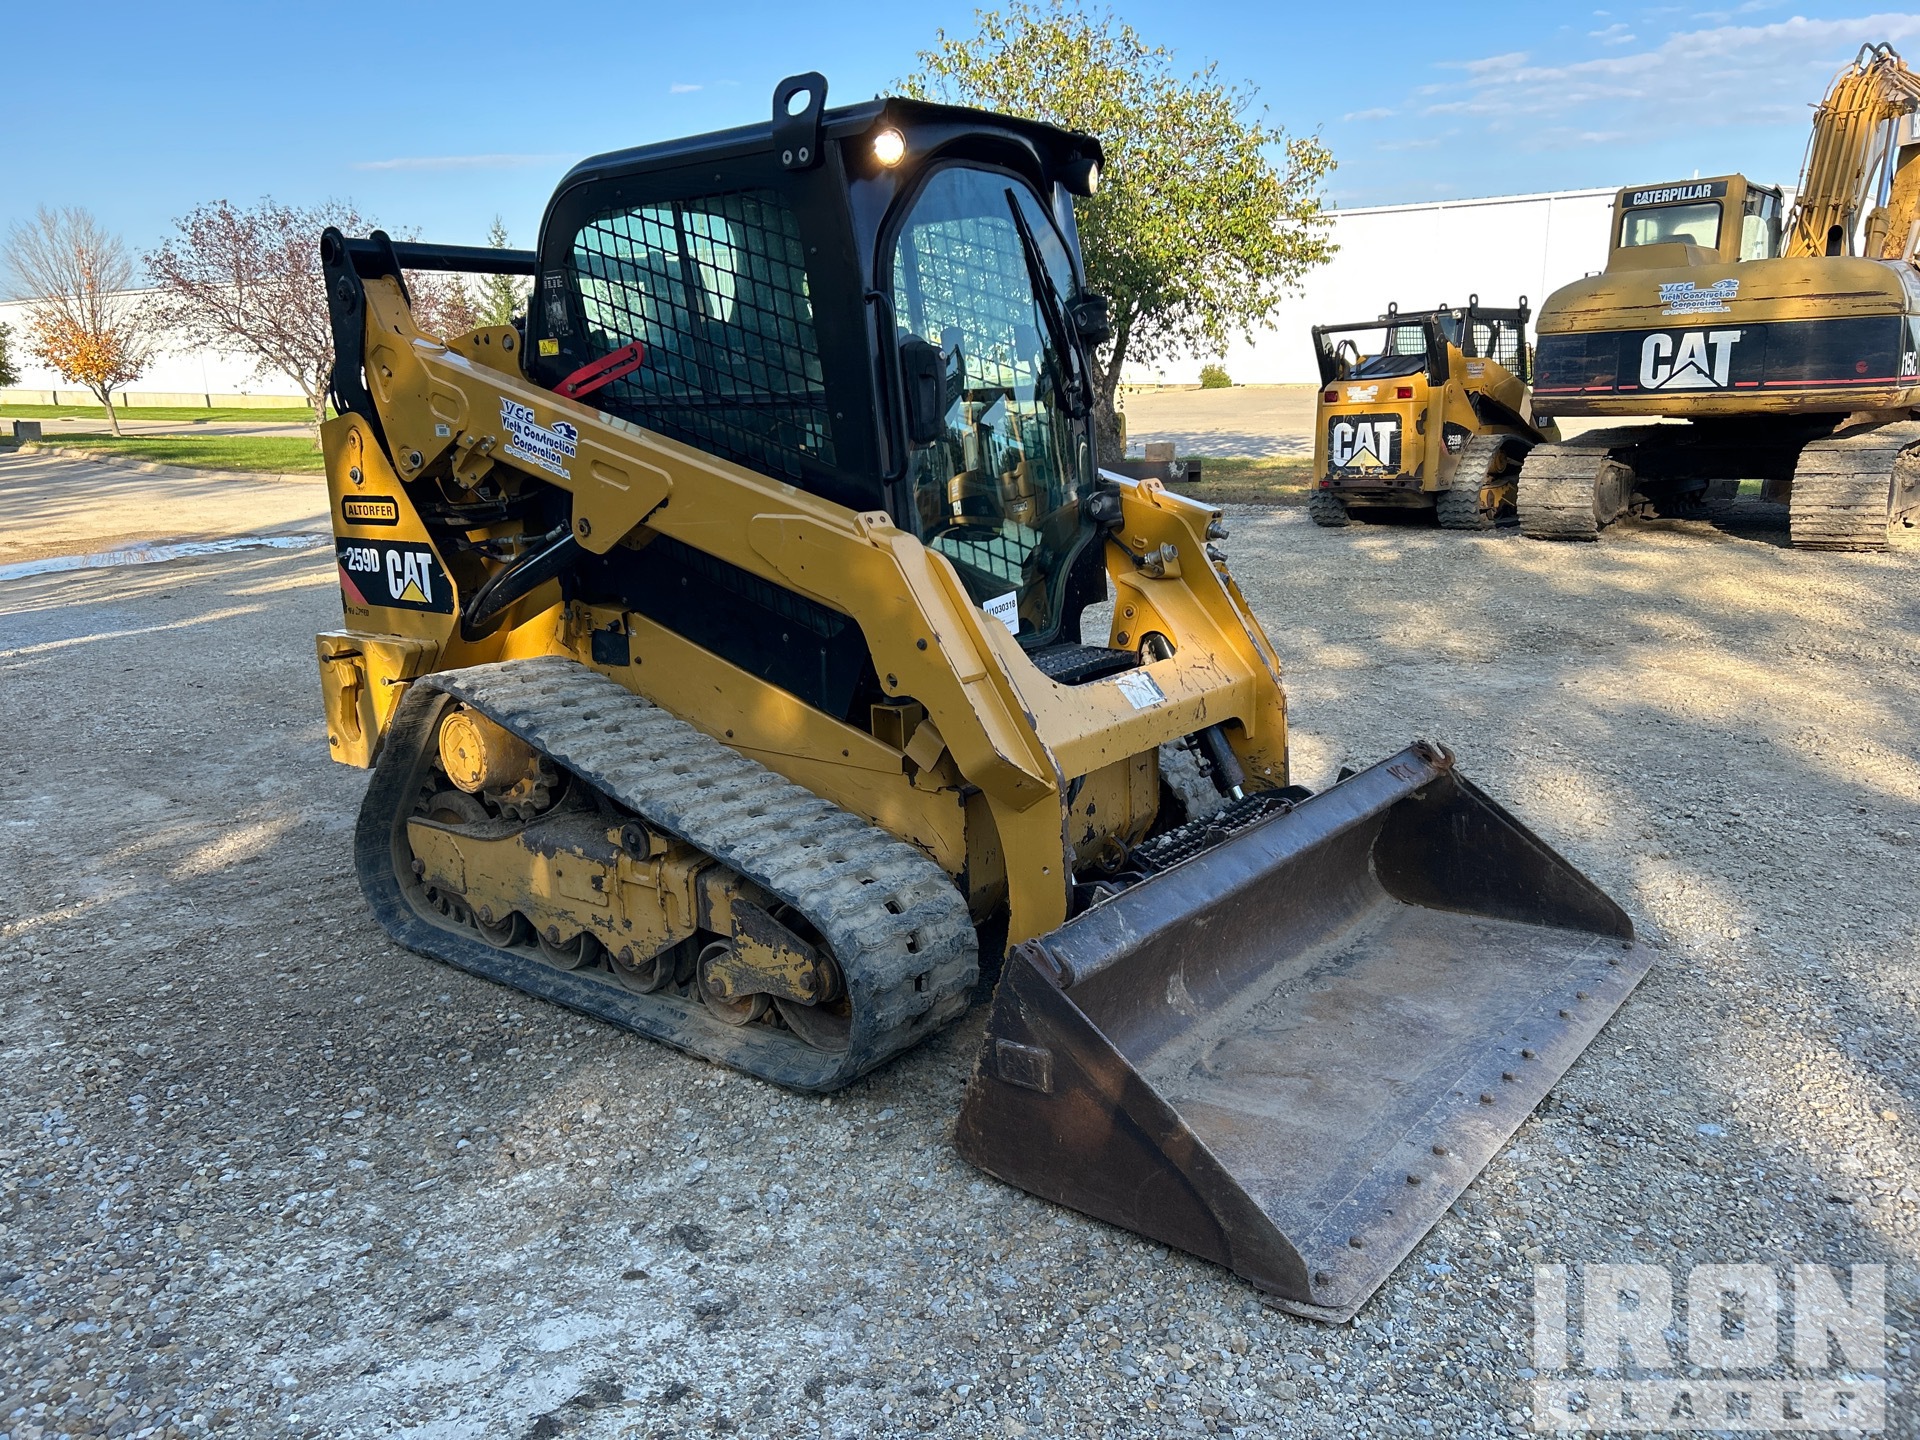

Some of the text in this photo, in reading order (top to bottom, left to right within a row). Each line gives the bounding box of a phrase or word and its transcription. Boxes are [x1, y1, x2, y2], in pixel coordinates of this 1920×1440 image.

[1632, 184, 1712, 206] CATERPILLAR
[1660, 290, 1736, 302] Vieth Construction
[1671, 300, 1721, 309] Corporation
[1640, 330, 1742, 390] CAT
[502, 415, 576, 457] Vieth Construction
[513, 434, 562, 465] Corporation
[1332, 421, 1397, 468] CAT
[348, 504, 393, 517] ALTORFER
[346, 547, 433, 604] 259D CAT
